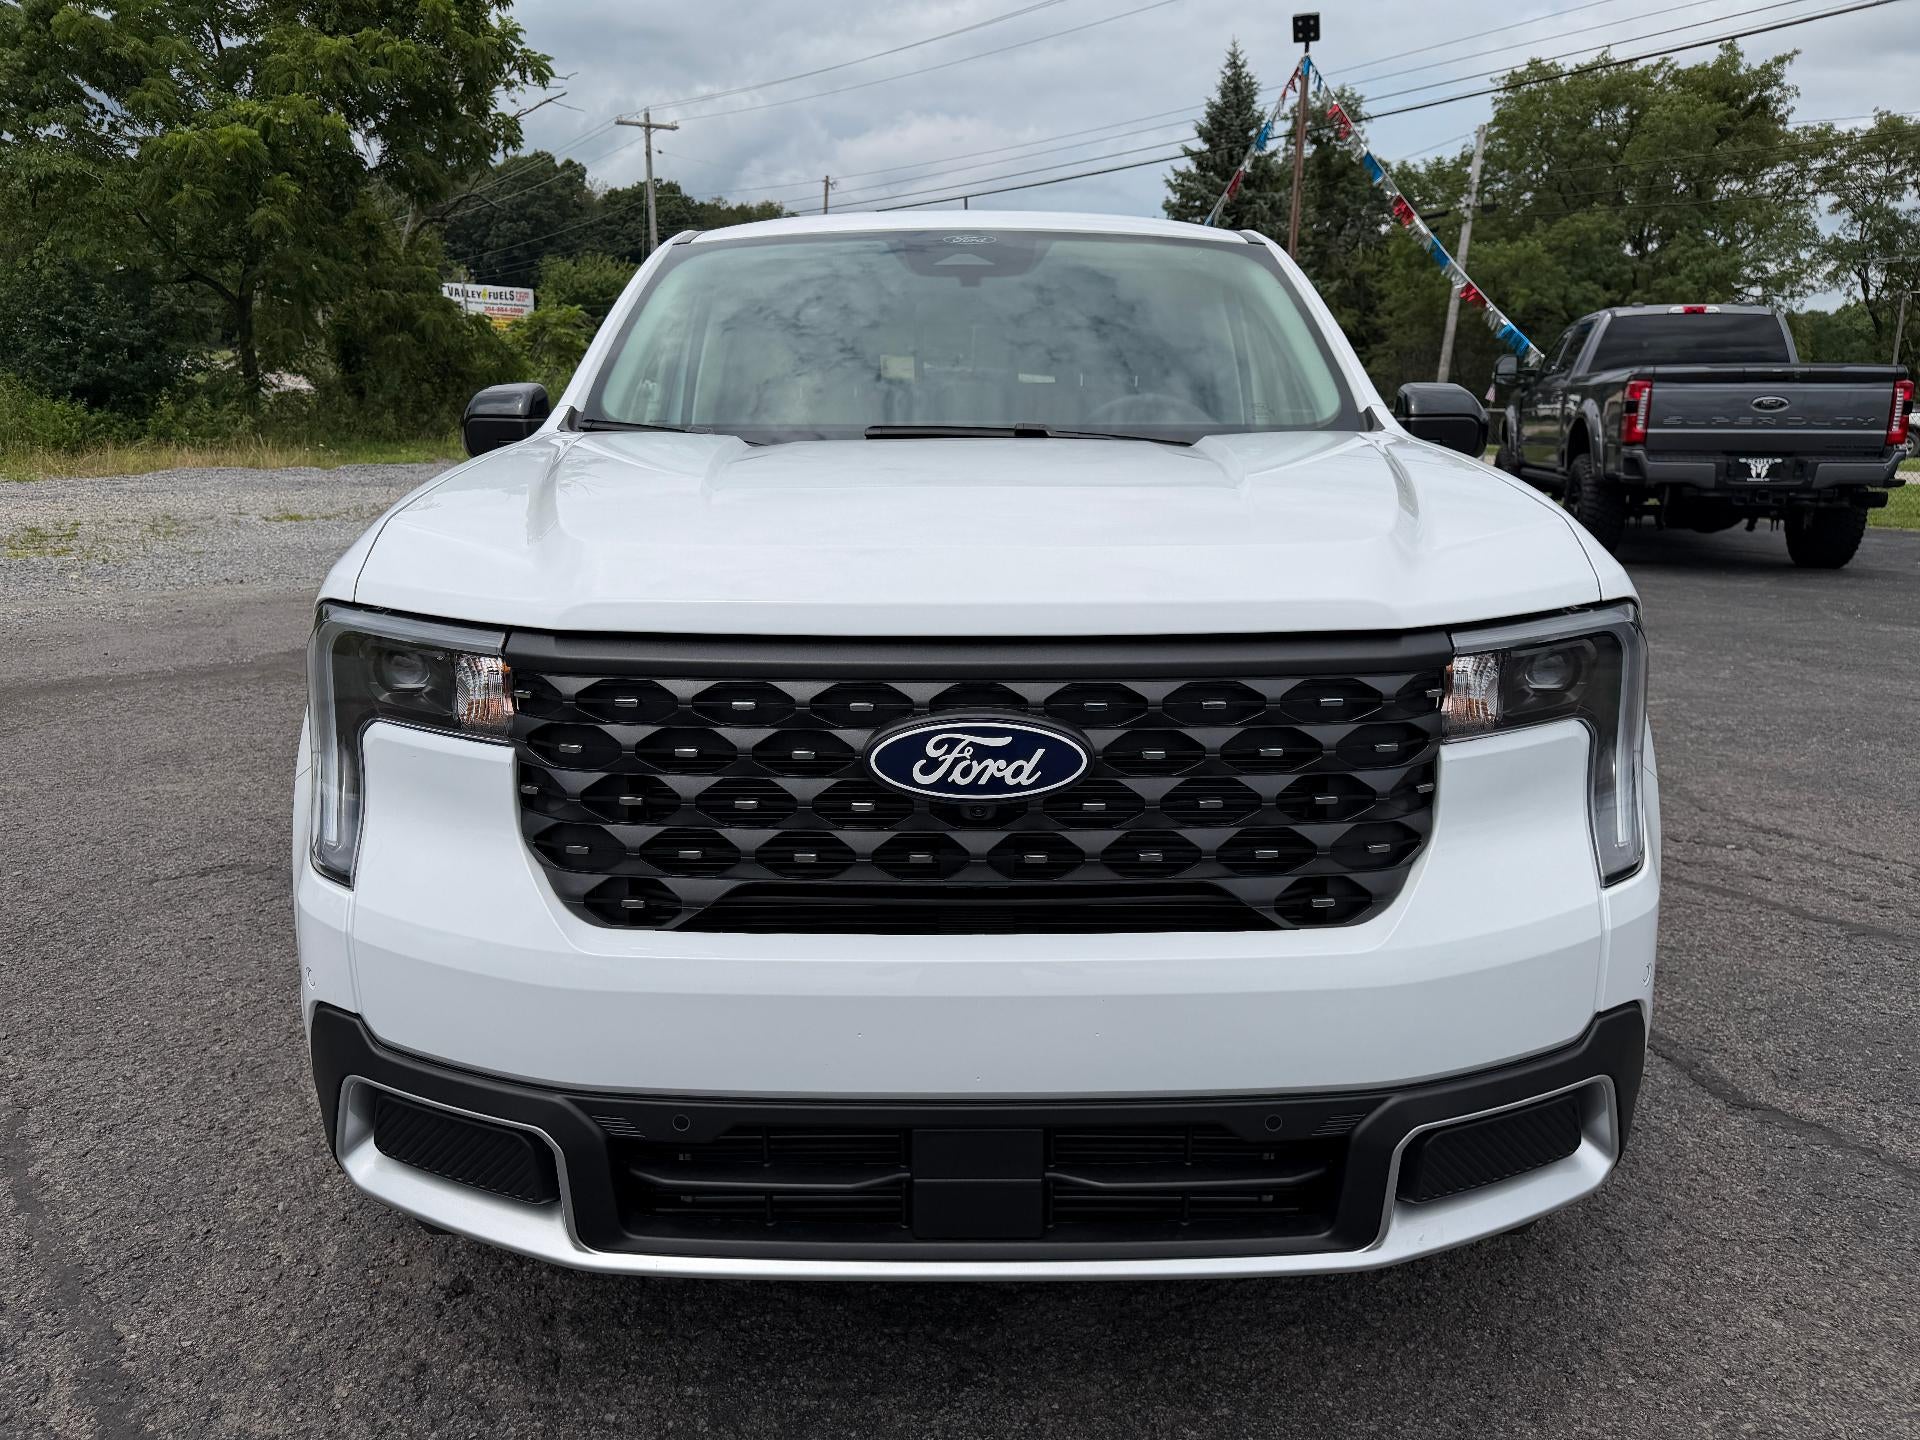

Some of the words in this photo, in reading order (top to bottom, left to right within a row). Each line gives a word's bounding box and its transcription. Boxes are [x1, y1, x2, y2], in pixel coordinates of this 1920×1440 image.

[447, 285, 482, 299] VALLEY
[488, 290, 515, 301] FUELS
[1663, 416, 1777, 426] SUPER
[1786, 416, 1876, 426] DUTY
[912, 733, 1046, 786] Ford
